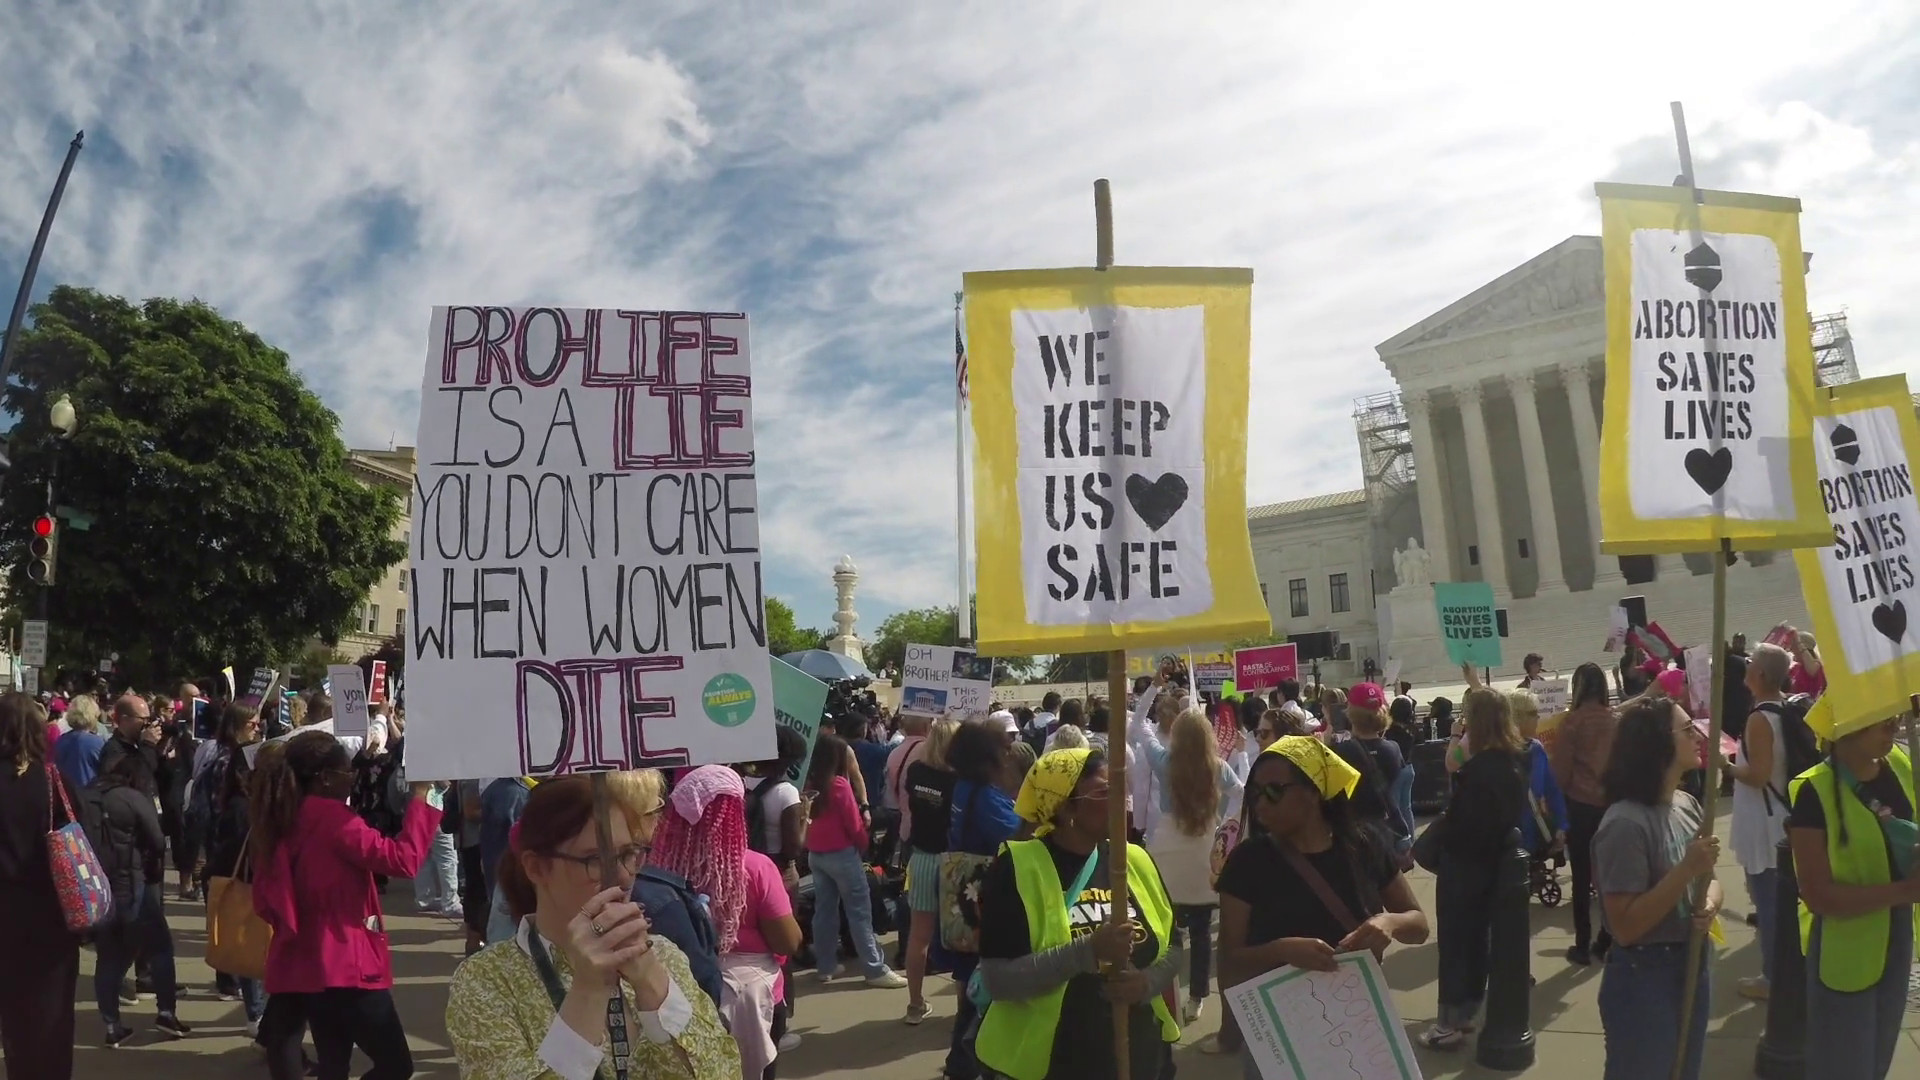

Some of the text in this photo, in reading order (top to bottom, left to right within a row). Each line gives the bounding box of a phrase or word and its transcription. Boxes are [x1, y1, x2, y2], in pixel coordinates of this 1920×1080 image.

[1634, 299, 1776, 340] ABORTION
[442, 306, 750, 387] PRO-LIFE
[1037, 331, 1111, 392] WE
[1656, 351, 1756, 394] SAVES
[430, 384, 754, 470] IS A LIE
[1043, 398, 1171, 458] KEEP
[1664, 400, 1753, 440] LIVES
[1045, 472, 1115, 532] US
[1819, 463, 1912, 514] BORTION
[413, 472, 758, 562] YOU DON'T CARE
[1833, 512, 1907, 561] SAVES
[1046, 541, 1180, 601] SAFE
[1846, 554, 1915, 603] LIVES
[410, 562, 765, 660] WHEN WOMEN
[1442, 605, 1490, 614] ABORTION
[1443, 614, 1492, 626] SAVES
[1445, 626, 1493, 639] LIVES
[904, 664, 950, 682] BROTHER!
[908, 648, 932, 661] OH
[1242, 663, 1264, 671] BASTA
[707, 690, 753, 706] ALWAYS
[952, 687, 977, 697] THIS
[516, 656, 690, 777] DIE
[774, 707, 812, 738] RTION
[1237, 993, 1264, 1044] LAW CENTER
[1245, 989, 1267, 1033] NATIONAL
